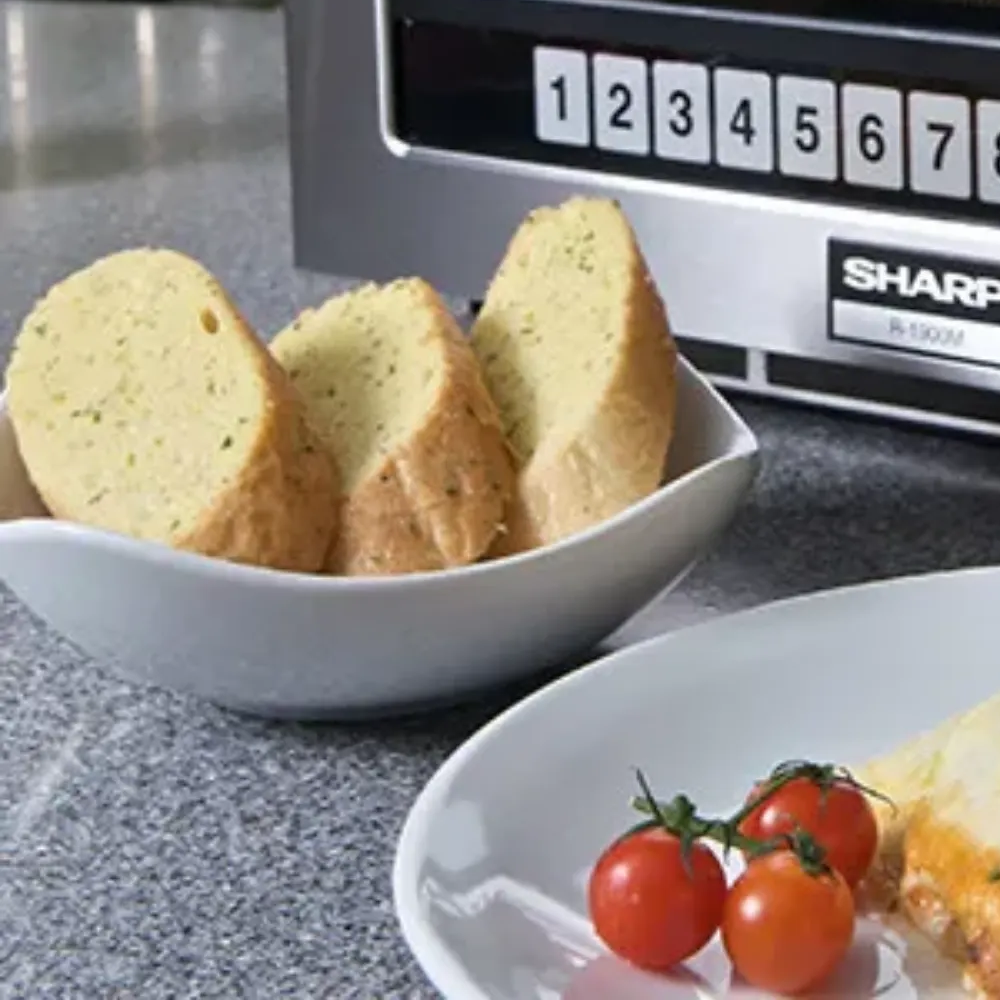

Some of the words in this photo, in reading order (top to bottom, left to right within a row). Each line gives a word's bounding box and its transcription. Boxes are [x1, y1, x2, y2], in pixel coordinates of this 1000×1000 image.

[550, 75, 567, 121] 1
[608, 82, 634, 131] 2
[668, 89, 694, 138] 3
[729, 98, 756, 147] 4
[794, 105, 821, 153] 5
[858, 113, 886, 164] 6
[926, 121, 956, 172] 7
